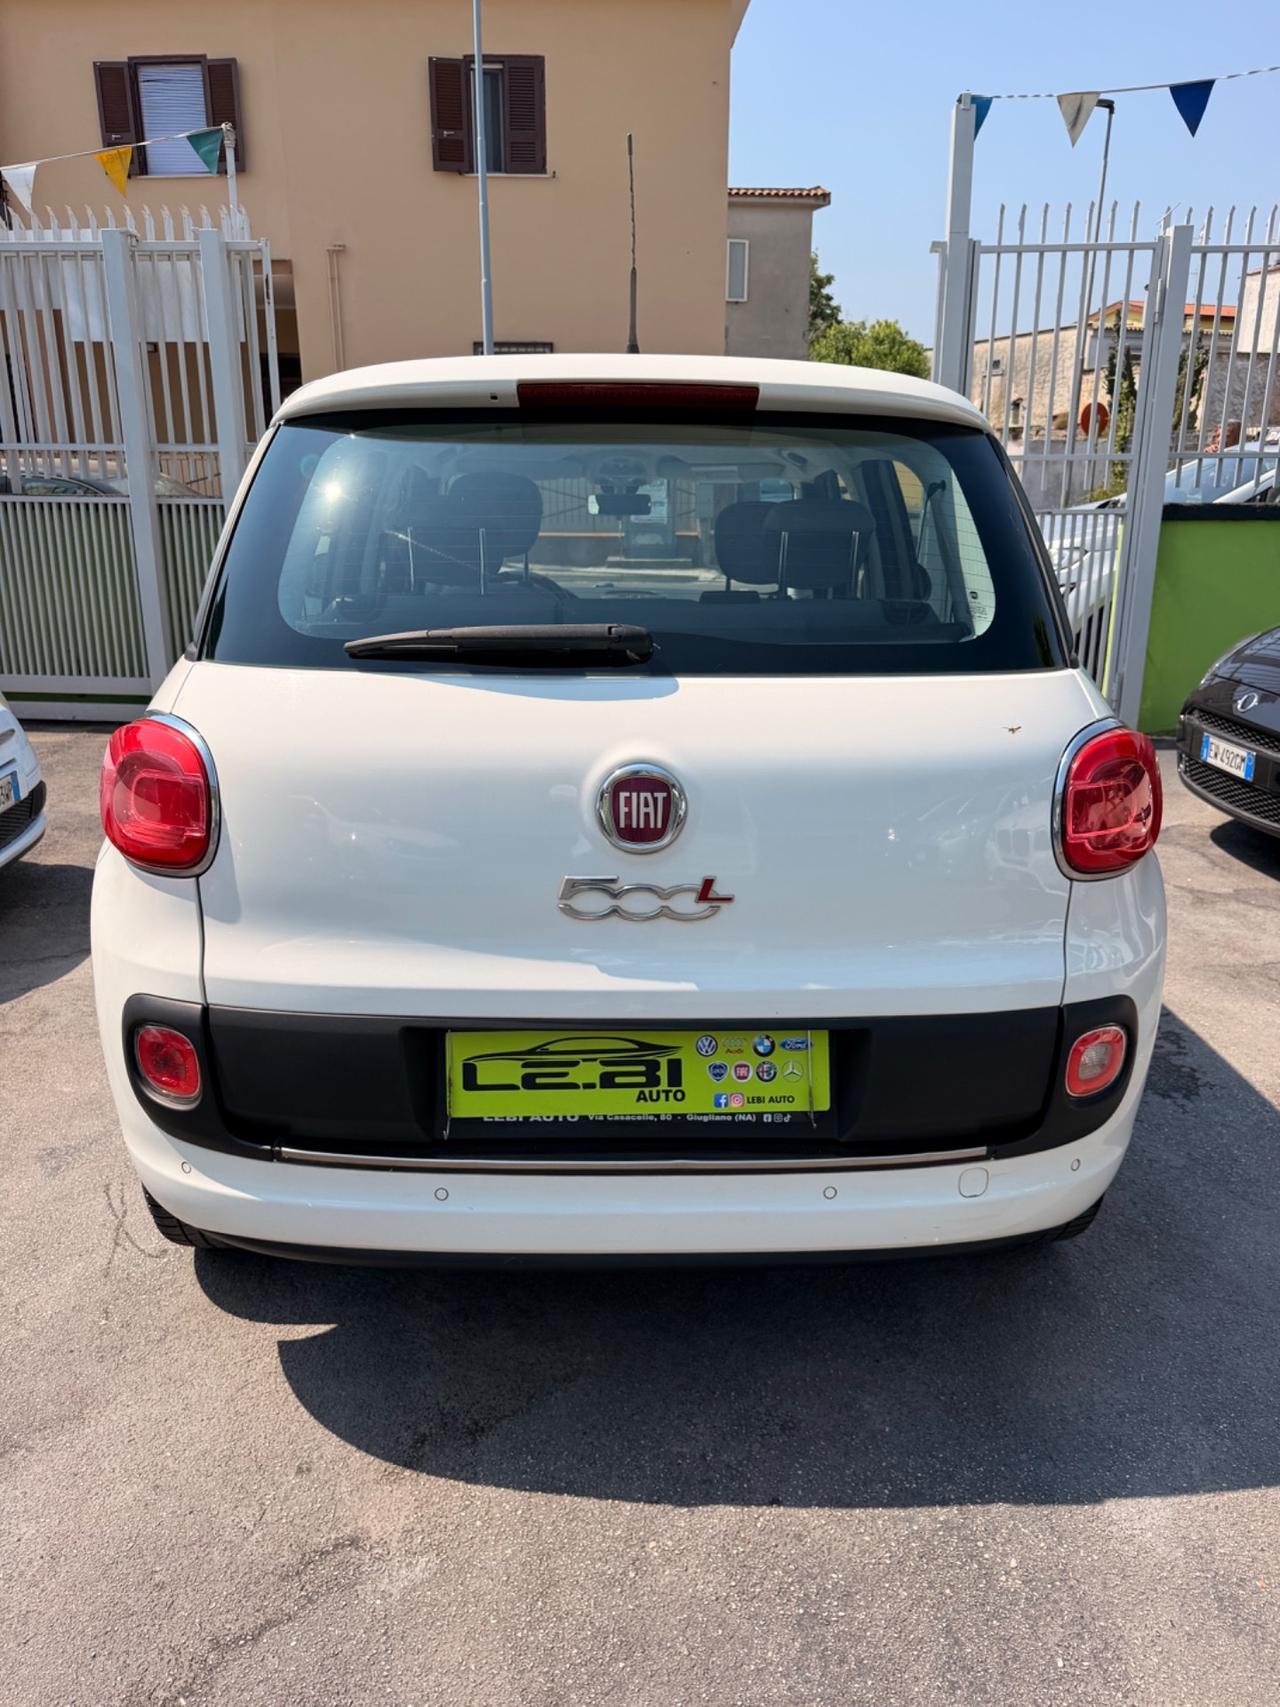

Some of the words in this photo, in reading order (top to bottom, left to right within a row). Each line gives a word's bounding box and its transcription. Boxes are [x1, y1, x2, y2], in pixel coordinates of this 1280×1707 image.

[618, 791, 668, 829] FIAT
[557, 875, 735, 921] 500L
[635, 1088, 686, 1104] AUTO
[746, 1095, 766, 1105] LEBI
[767, 1095, 795, 1104] AUTO
[686, 1113, 733, 1123] Giugliano
[734, 1113, 757, 1123] (NA)
